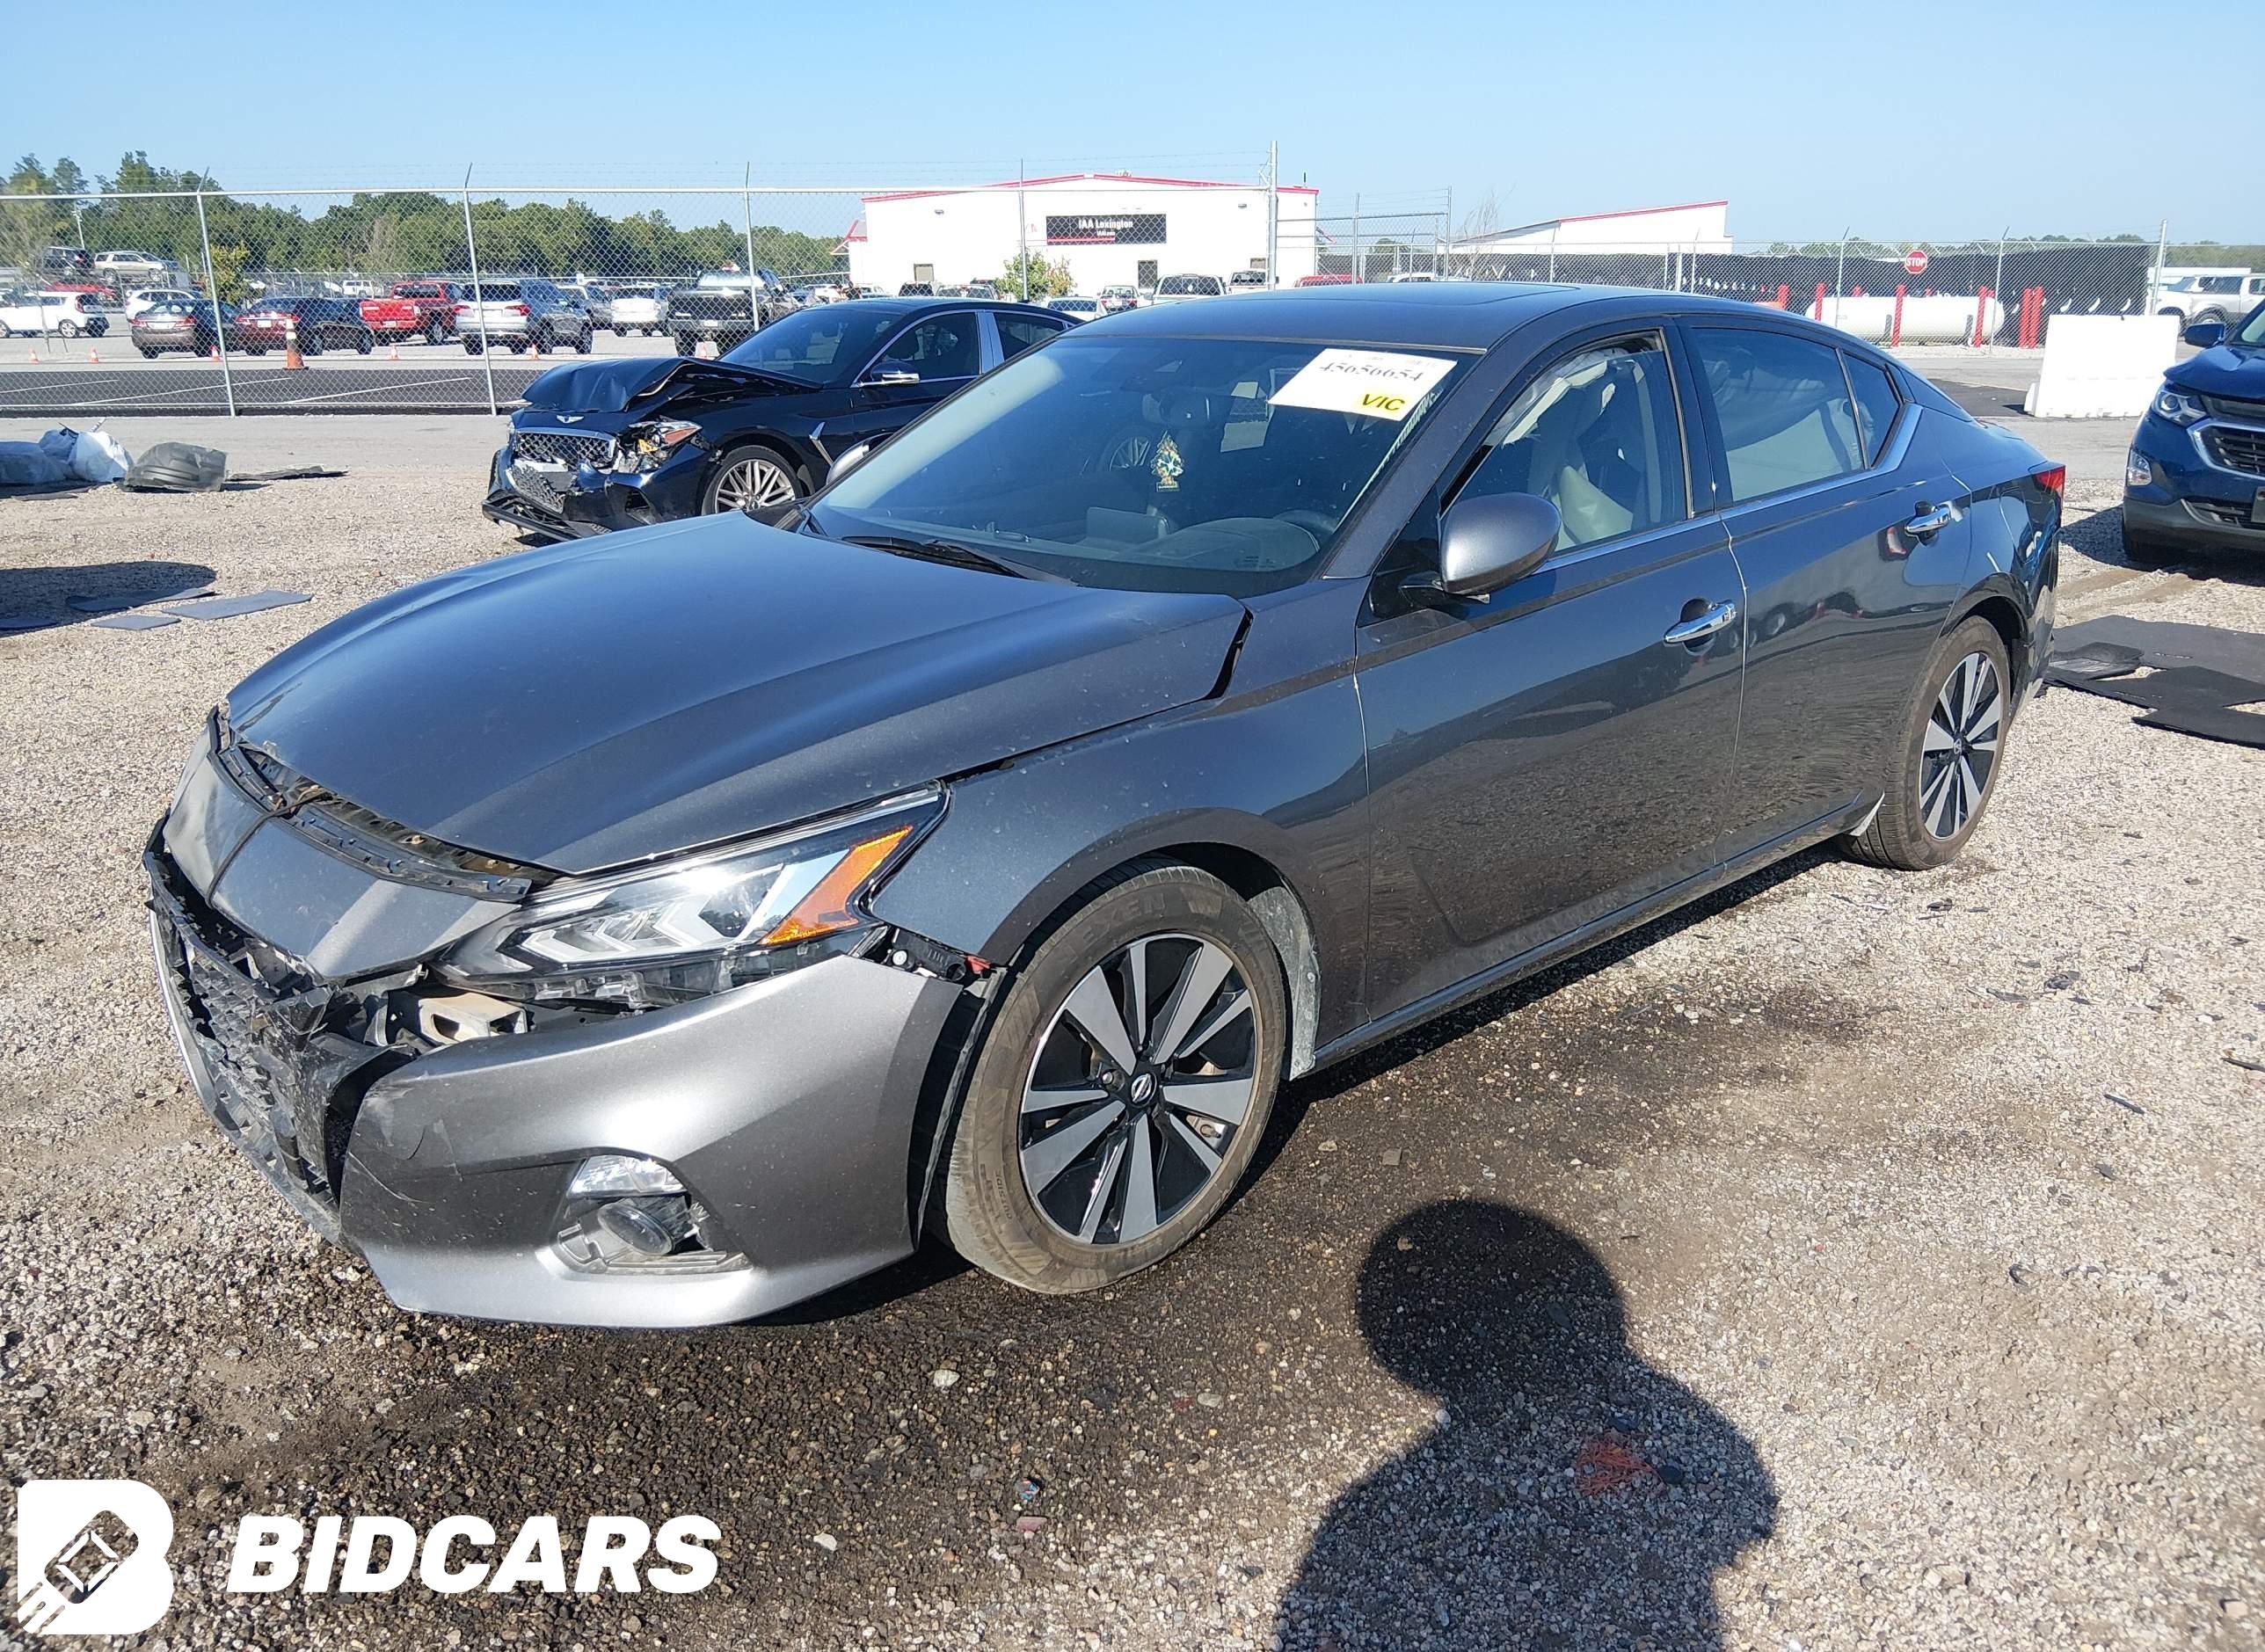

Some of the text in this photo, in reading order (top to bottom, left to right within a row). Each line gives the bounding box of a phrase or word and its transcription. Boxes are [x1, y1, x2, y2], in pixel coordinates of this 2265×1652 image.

[1078, 218, 1133, 230] IAA Lexington
[1905, 257, 1926, 266] STOP
[1362, 394, 1405, 411] VIC
